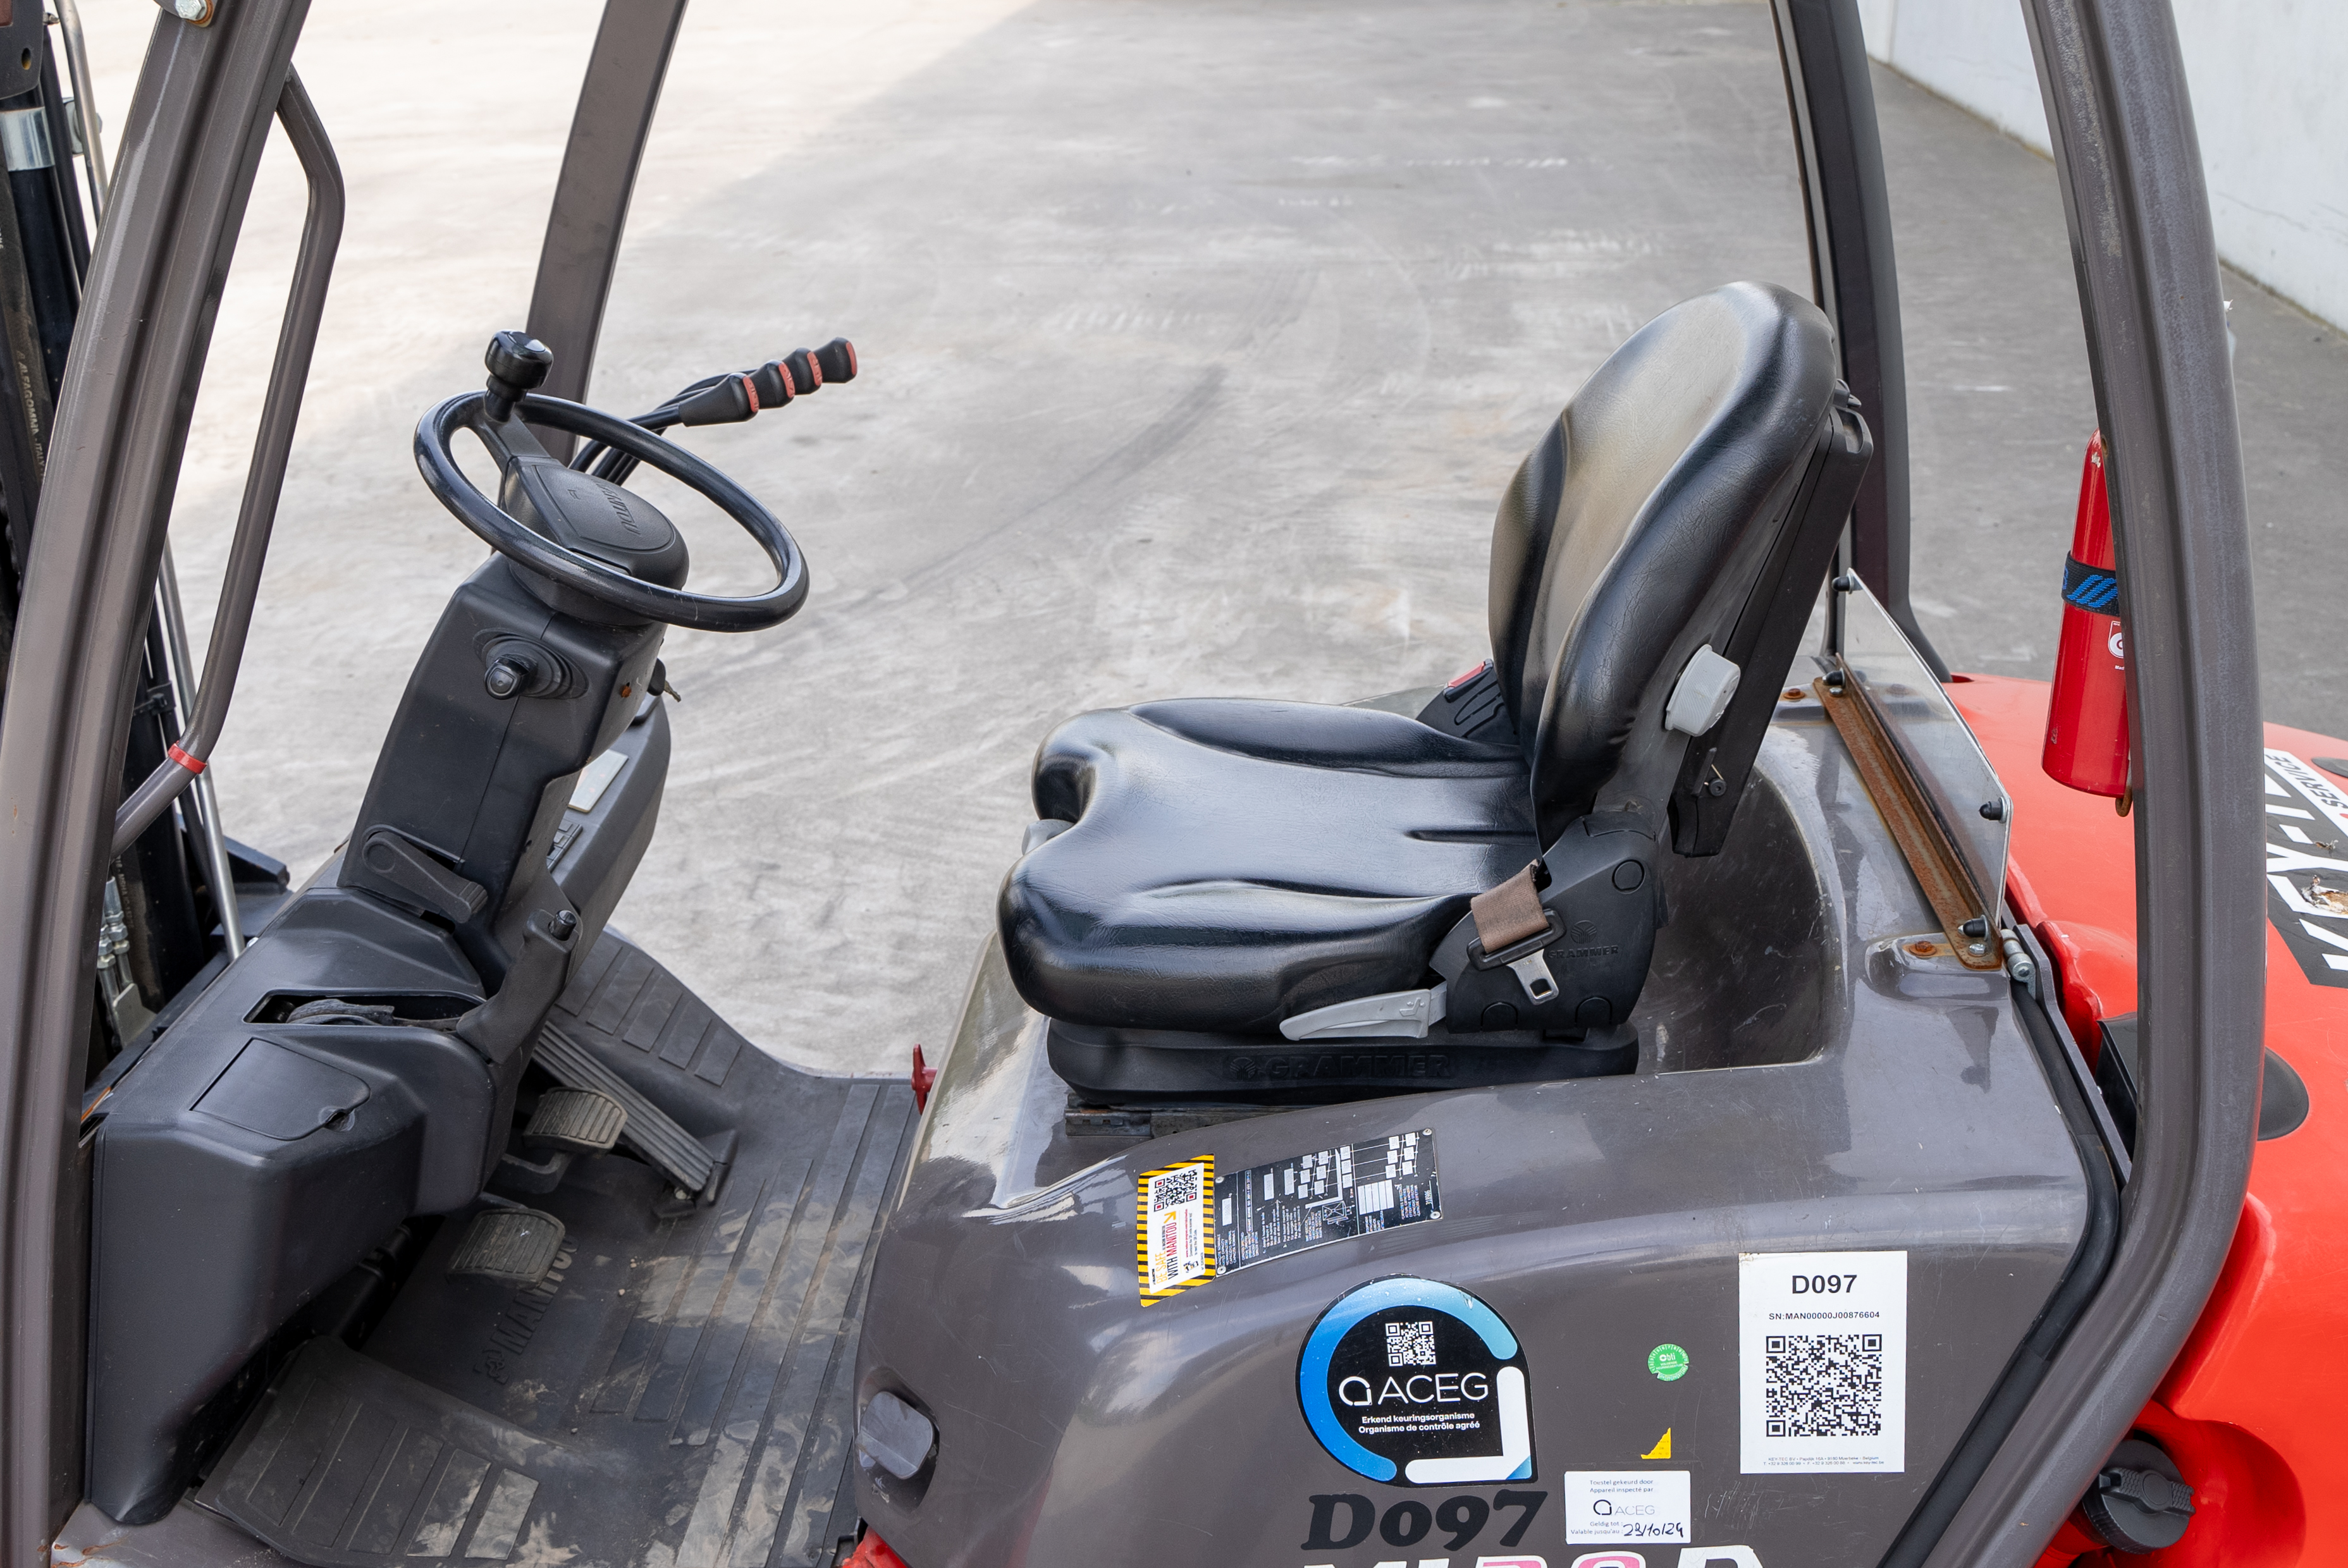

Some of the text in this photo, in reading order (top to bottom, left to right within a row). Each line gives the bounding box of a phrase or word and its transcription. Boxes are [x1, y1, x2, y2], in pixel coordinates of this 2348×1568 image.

[2266, 753, 2347, 810] SERVICE
[1548, 945, 1619, 959] GRAMMER
[1265, 1055, 1450, 1078] GRAMMER
[1165, 1221, 1178, 1280] WITH MANITOU
[1155, 1250, 1167, 1283] BE SAFE
[1792, 1275, 1857, 1294] D097
[1769, 1311, 1880, 1320] SN:MAN00000J00876604
[1377, 1372, 1489, 1405] ACEG
[1358, 1424, 1404, 1435] Organisme
[1418, 1421, 1454, 1430] contrôle
[1456, 1421, 1480, 1430] agréé
[1361, 1412, 1475, 1424] Erkend keuringsorganisme
[1300, 1488, 1548, 1552] D097
[1614, 1505, 1655, 1516] ACEG
